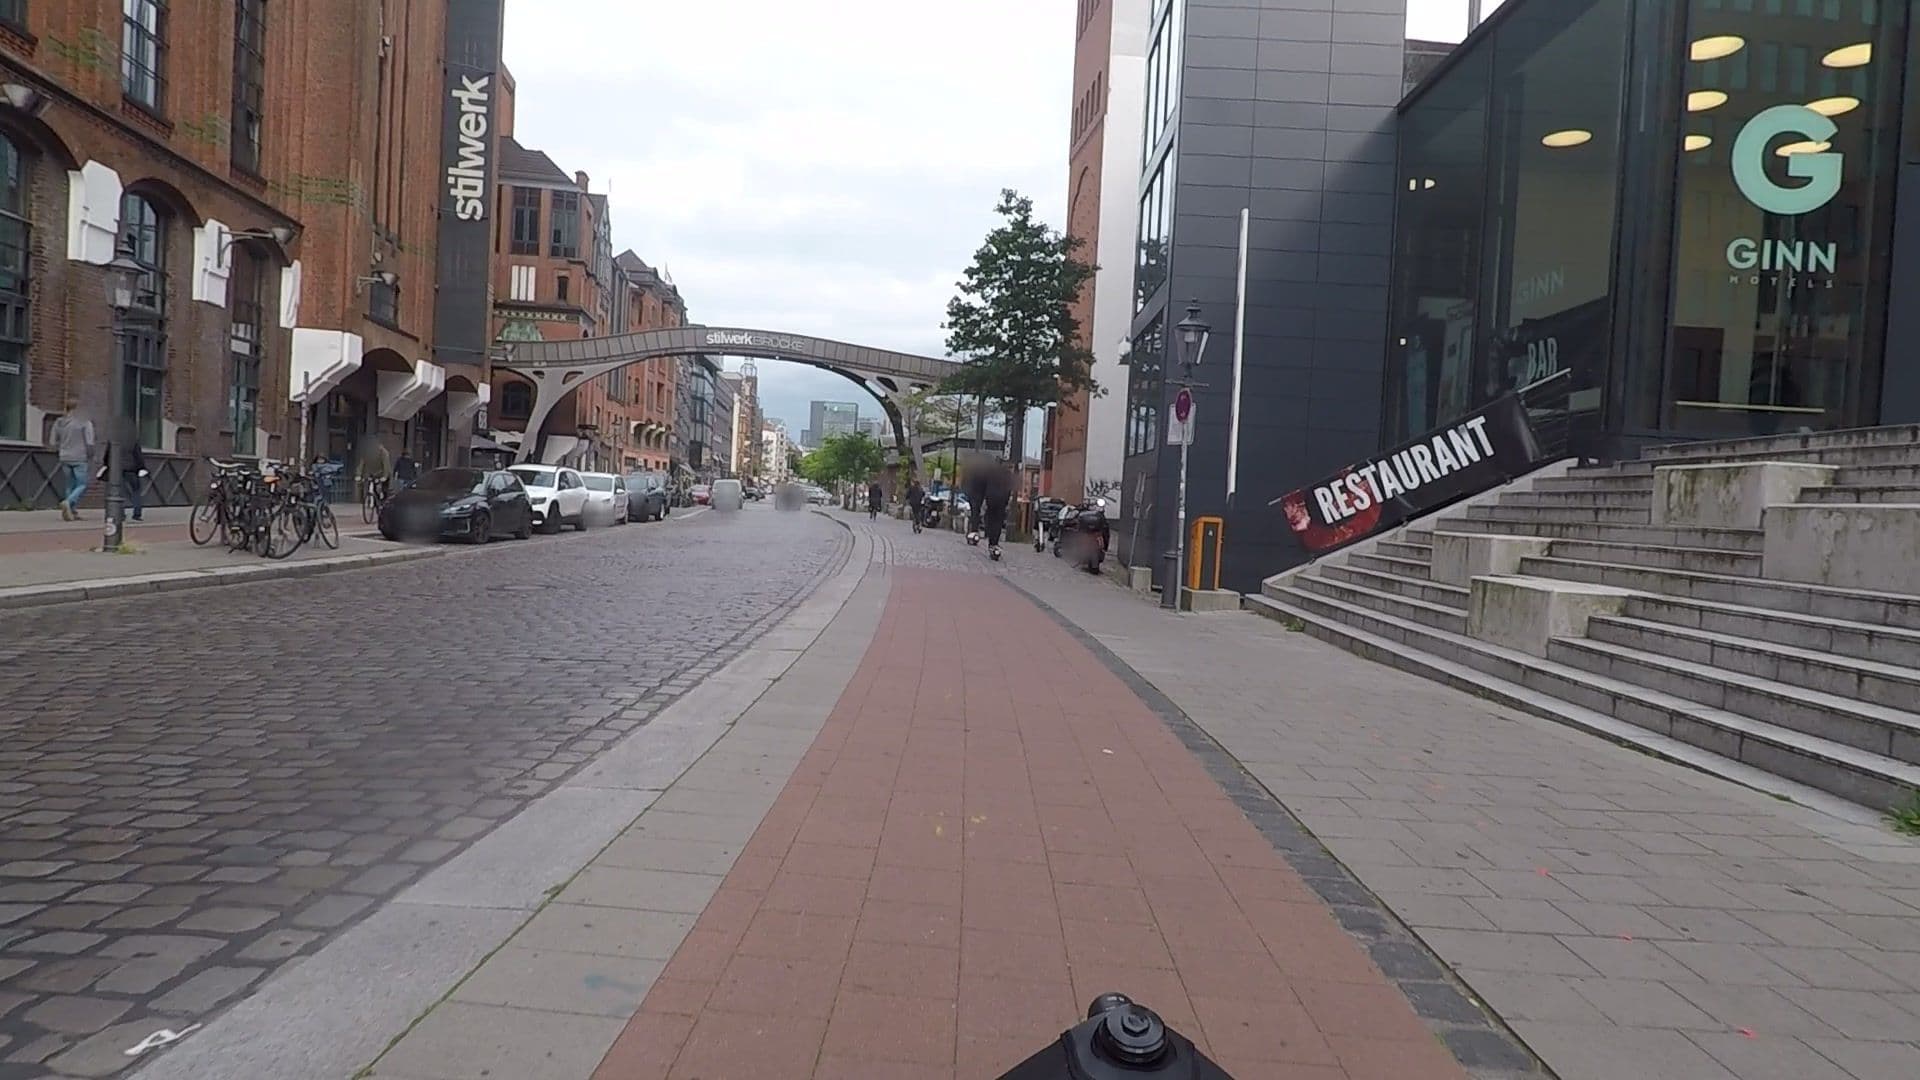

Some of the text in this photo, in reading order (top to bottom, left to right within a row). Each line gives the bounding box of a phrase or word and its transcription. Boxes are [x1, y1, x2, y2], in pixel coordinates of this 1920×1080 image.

[448, 74, 490, 221] stilwerk
[1731, 104, 1843, 215] G
[1726, 238, 1837, 274] GINN
[1729, 275, 1833, 289] HOTELS
[1526, 337, 1558, 382] BAR
[1313, 415, 1495, 525] RESTAURANT
